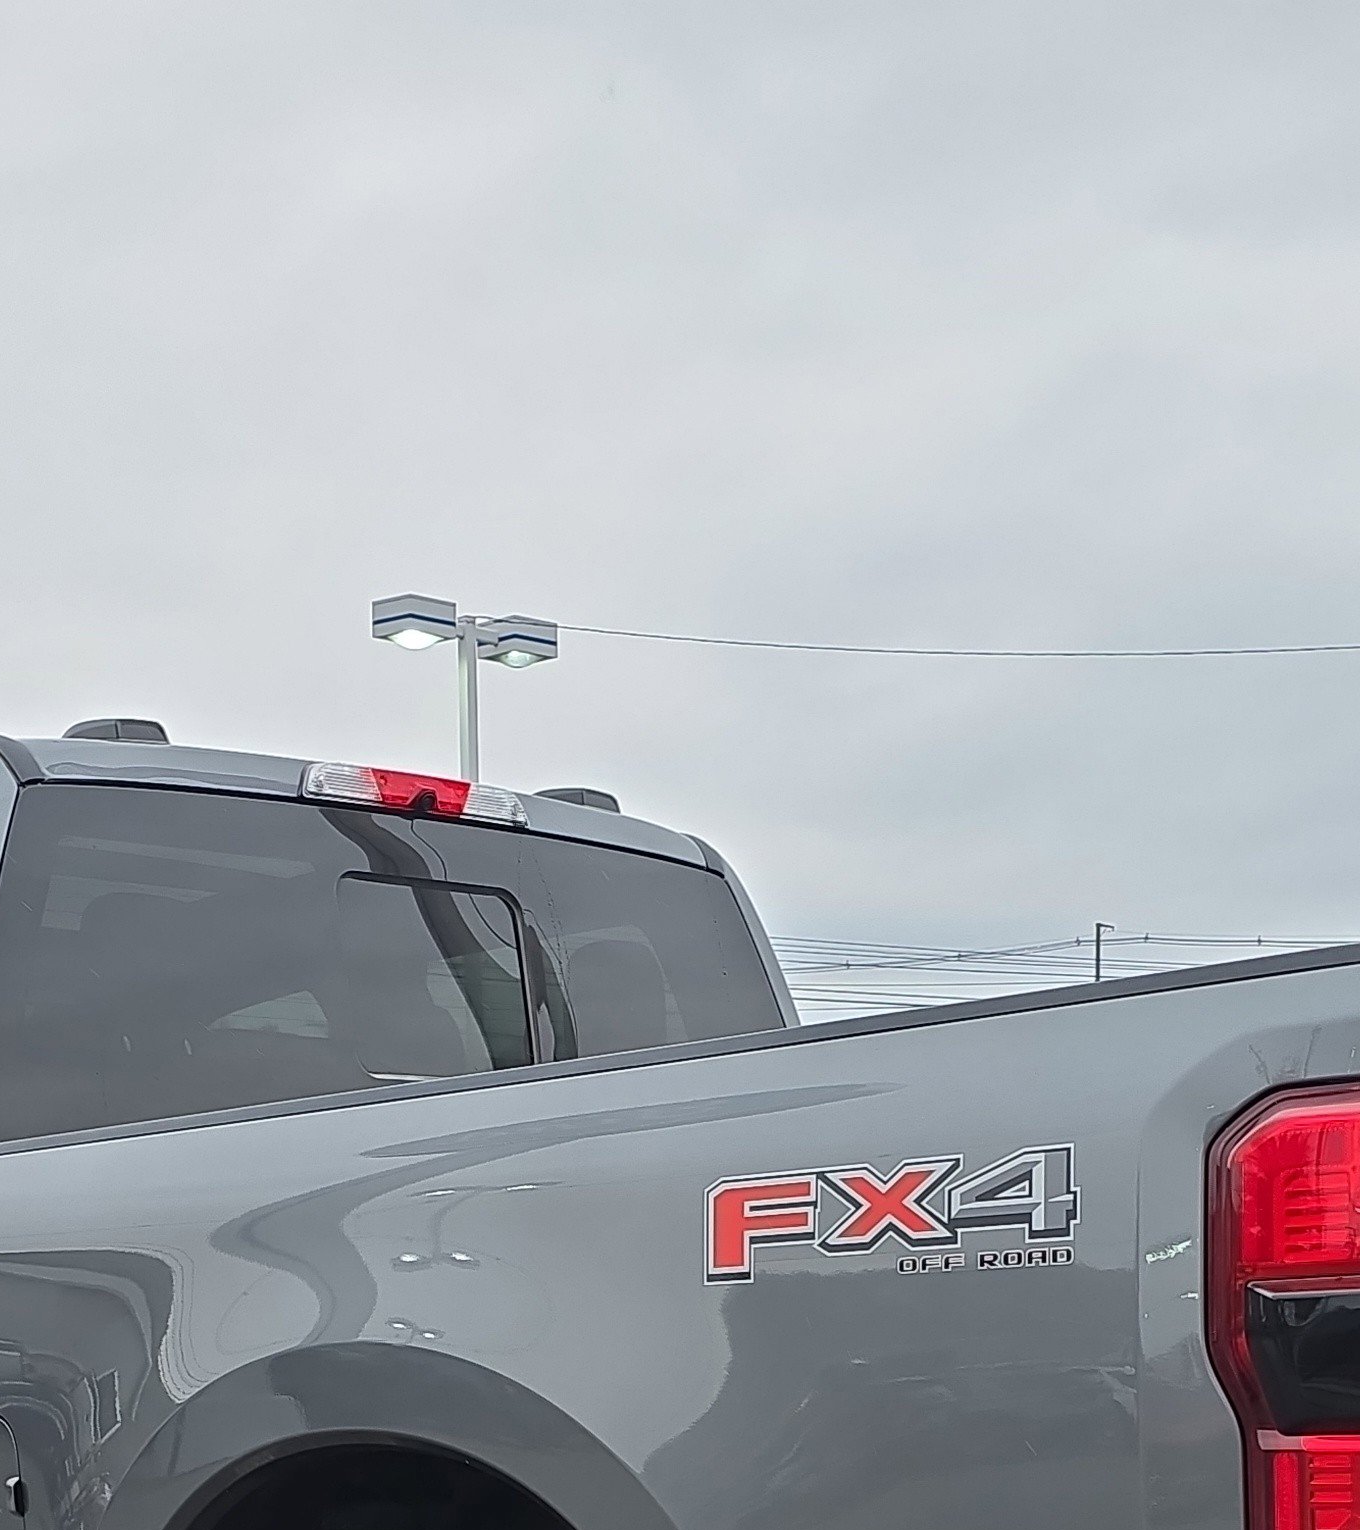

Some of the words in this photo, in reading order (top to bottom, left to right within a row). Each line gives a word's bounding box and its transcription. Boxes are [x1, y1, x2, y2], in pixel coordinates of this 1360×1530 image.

[703, 1142, 1081, 1285] FX4
[897, 1253, 965, 1275] OFF
[977, 1246, 1075, 1271] ROAD
